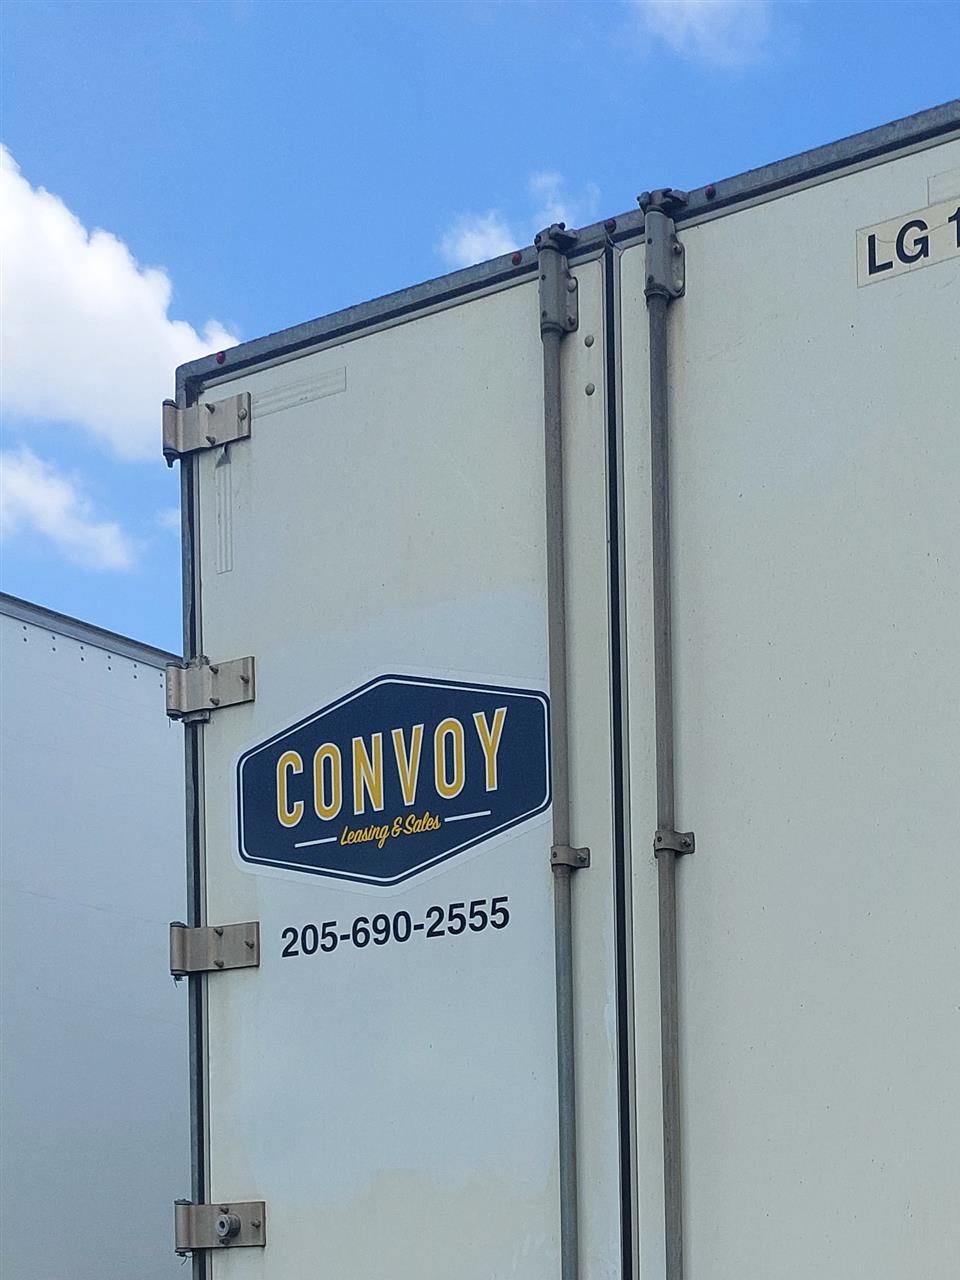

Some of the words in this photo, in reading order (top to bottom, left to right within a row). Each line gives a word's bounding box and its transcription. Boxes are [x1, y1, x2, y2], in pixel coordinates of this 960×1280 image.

[867, 219, 930, 276] LG
[276, 706, 508, 828] CONVOY
[340, 822, 390, 849] Leasing
[391, 816, 402, 836] &
[402, 811, 442, 837] Sales
[281, 896, 511, 958] 205-690-2555
